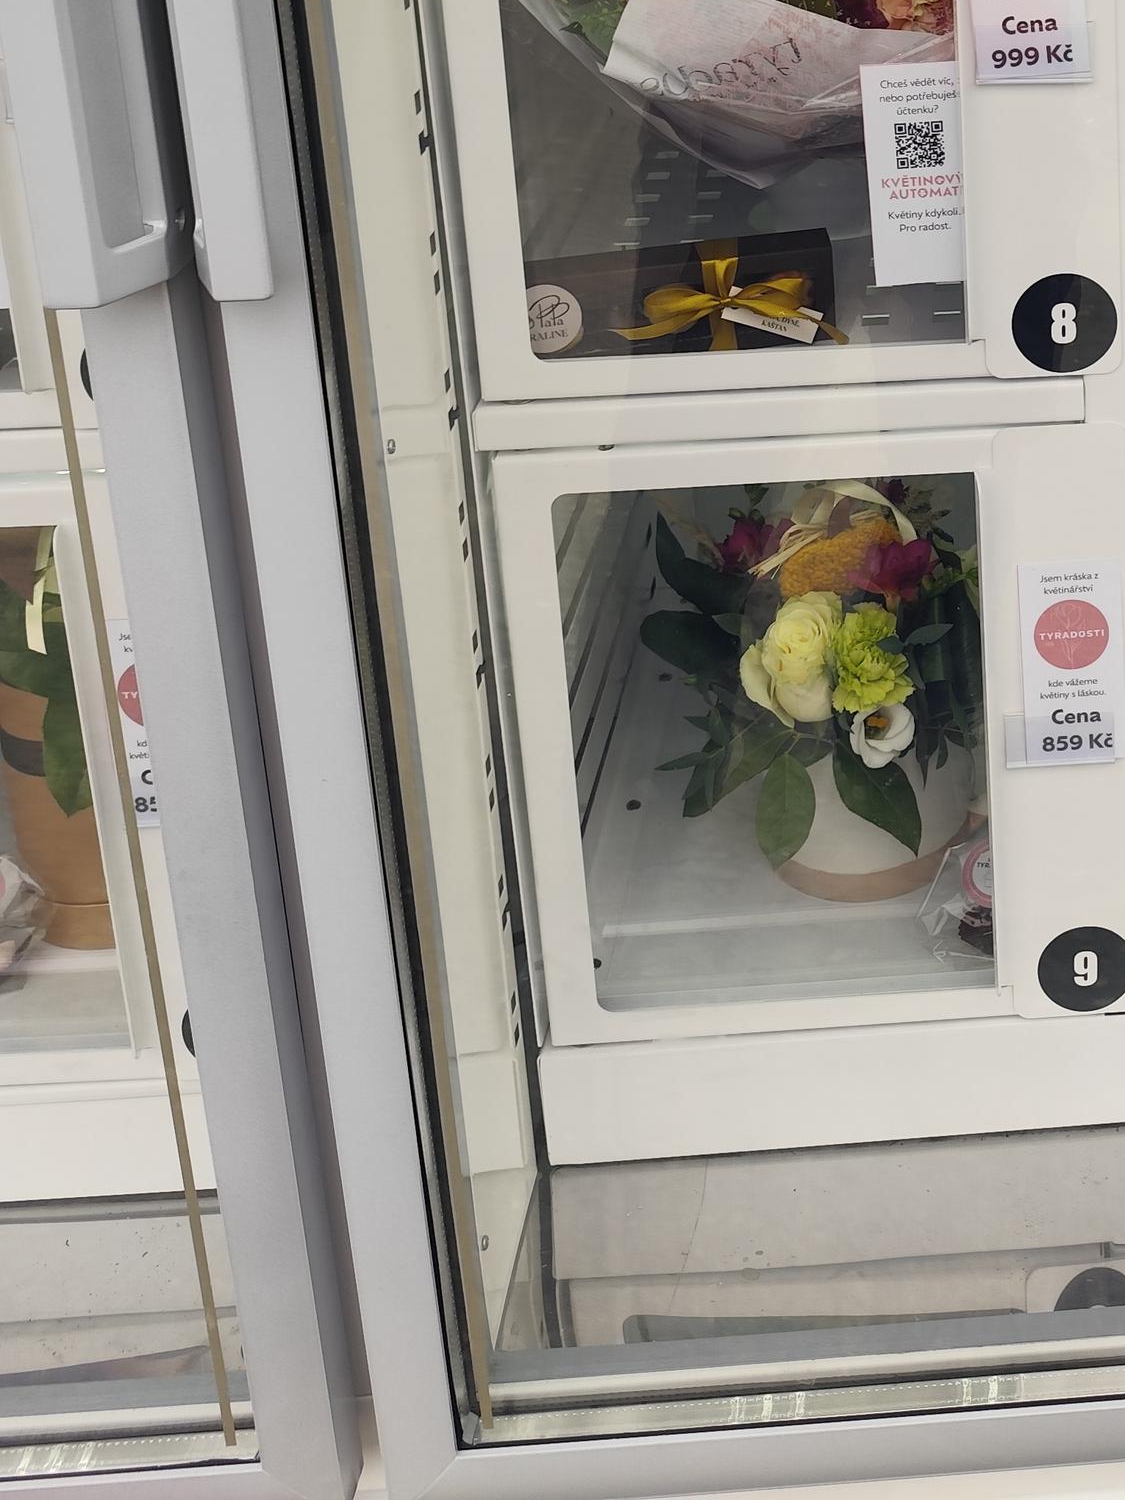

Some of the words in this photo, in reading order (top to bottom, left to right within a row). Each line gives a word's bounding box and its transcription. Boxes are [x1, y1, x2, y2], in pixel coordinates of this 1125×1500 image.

[1001, 16, 1058, 35] Cena
[991, 46, 1040, 69] 999
[1046, 44, 1073, 64] Kč
[880, 79, 908, 89] Chceš
[910, 77, 936, 87] vědět
[938, 76, 954, 86] víc,
[880, 94, 904, 103] nebo
[906, 90, 957, 102] potřebuješ
[896, 104, 939, 115] účtenku?
[889, 186, 959, 200] AUTOMAT
[888, 211, 923, 220] Květiny
[899, 223, 917, 232] Pro
[918, 222, 952, 231] radost.
[1051, 302, 1077, 344] 8
[1040, 575, 1062, 583] Jsem
[1064, 573, 1092, 581] kráska
[1043, 584, 1094, 595] květinářství
[1040, 629, 1105, 641] TYRADOSTI
[1048, 680, 1064, 688] kde
[1065, 678, 1098, 686] vážeme
[1040, 691, 1070, 700] květiny
[1051, 709, 1102, 725] Cena
[1042, 734, 1083, 753] 859
[1089, 733, 1113, 749] Kč
[1073, 950, 1098, 987] 9
